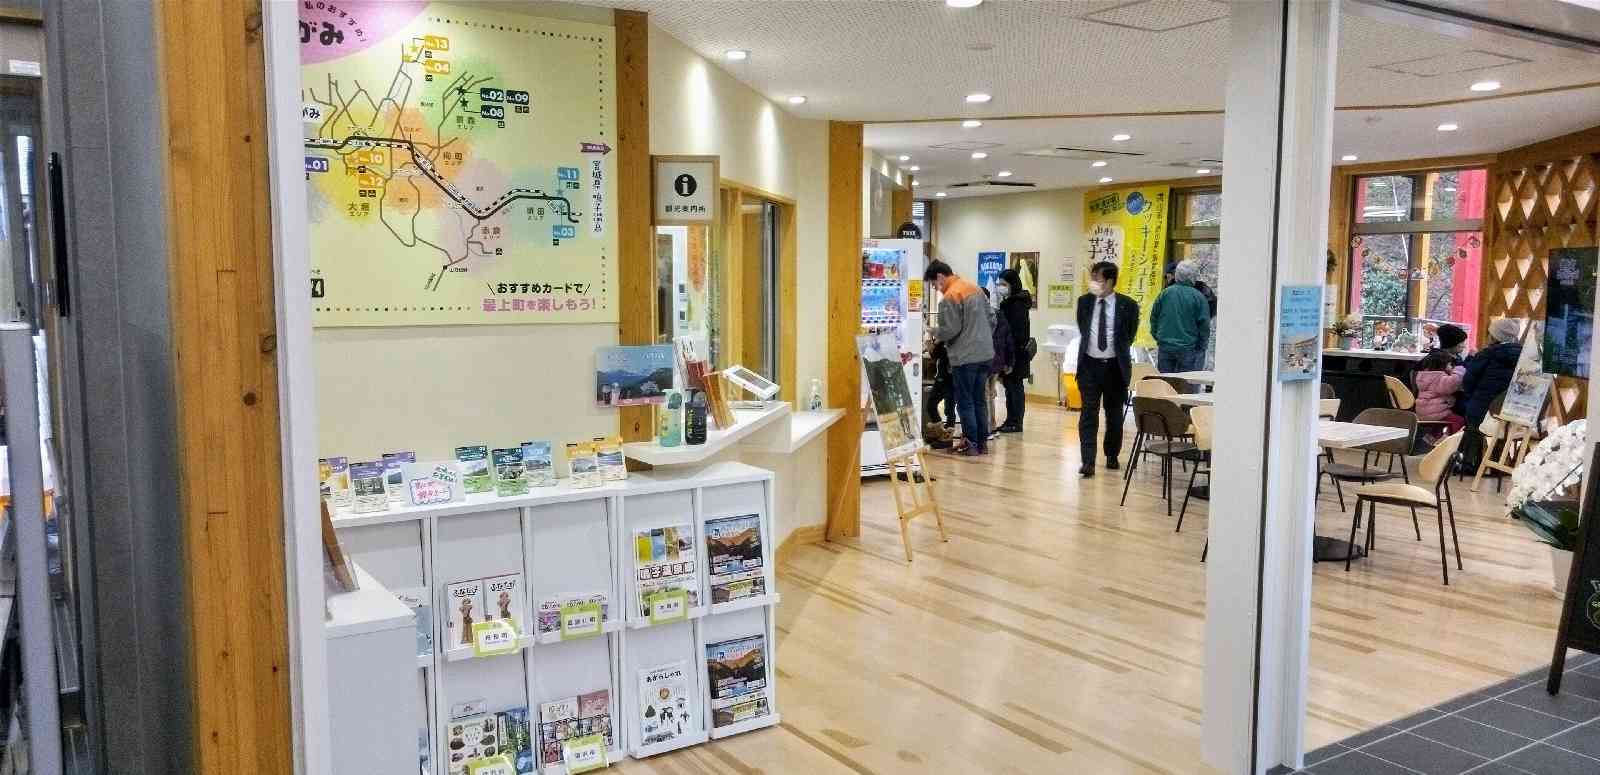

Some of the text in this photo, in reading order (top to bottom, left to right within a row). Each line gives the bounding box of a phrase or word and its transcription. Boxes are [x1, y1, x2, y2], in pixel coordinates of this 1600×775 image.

[665, 205, 706, 213] 観光案内所
[496, 282, 584, 294] おすすめカードで
[482, 298, 597, 312] 最上町を楽しもう!
